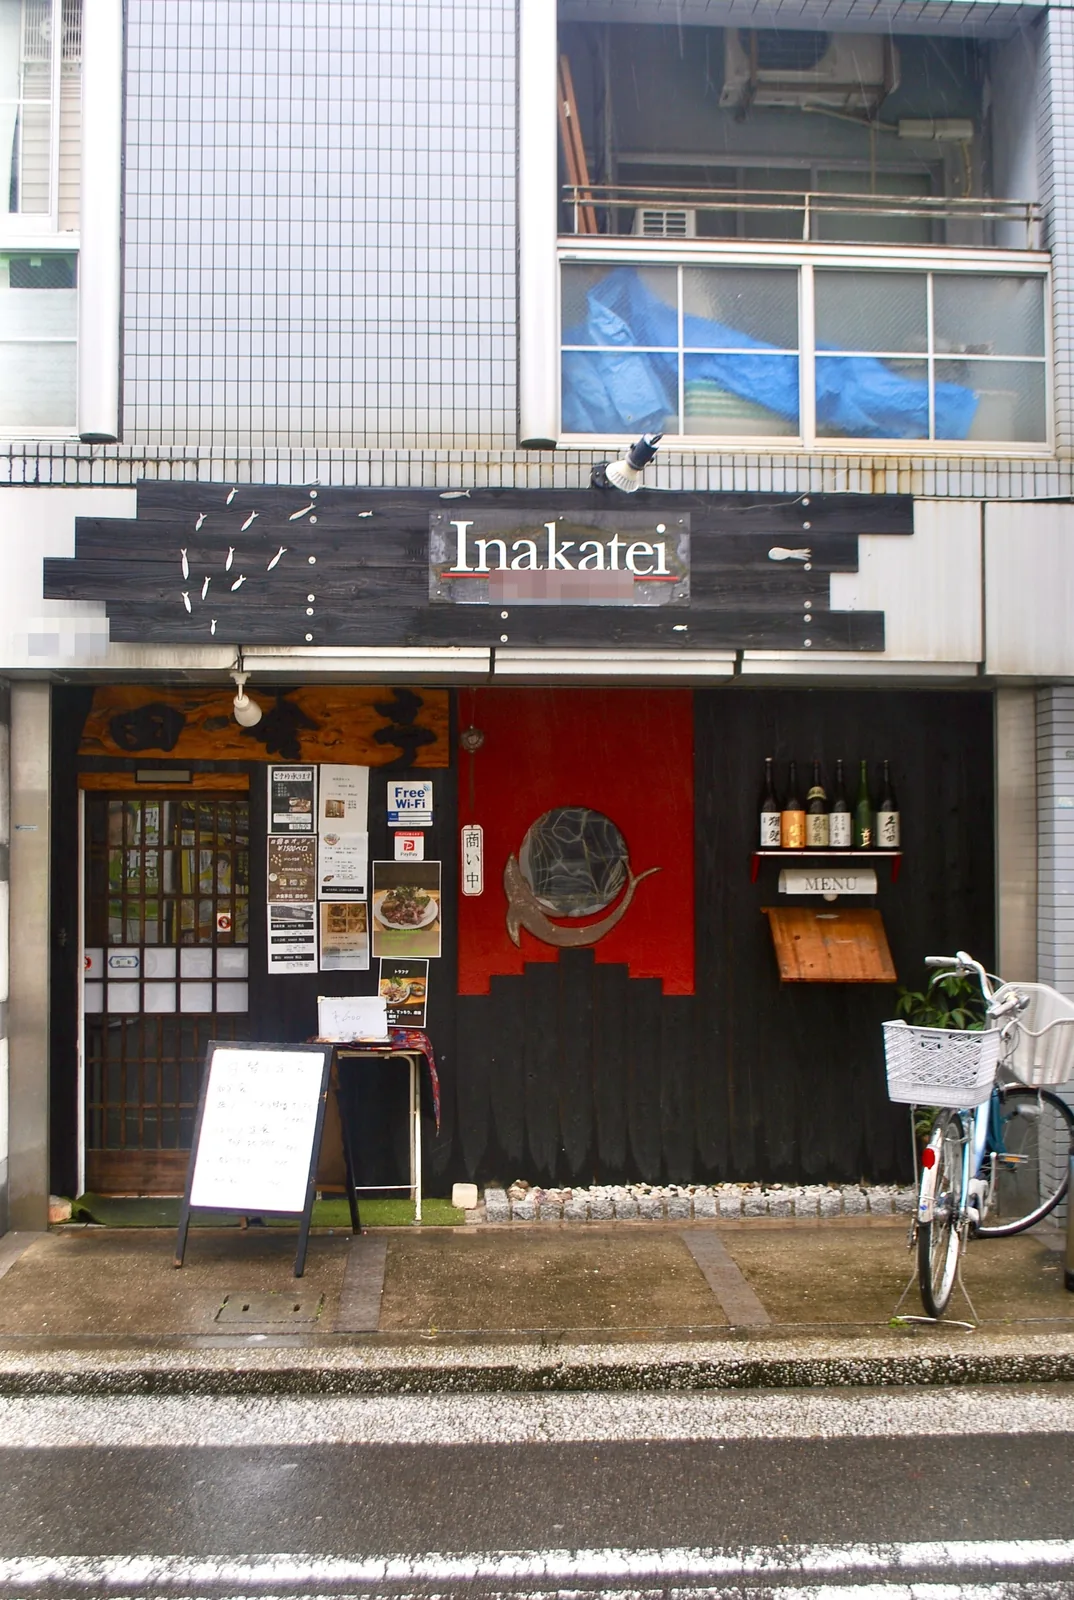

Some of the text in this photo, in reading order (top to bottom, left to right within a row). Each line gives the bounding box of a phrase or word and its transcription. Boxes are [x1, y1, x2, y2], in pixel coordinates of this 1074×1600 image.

[449, 520, 671, 575] Inakatei
[395, 787, 425, 798] Free
[395, 799, 425, 808] Wi-Fi
[466, 832, 480, 889] 商い中
[804, 876, 858, 891] MENU
